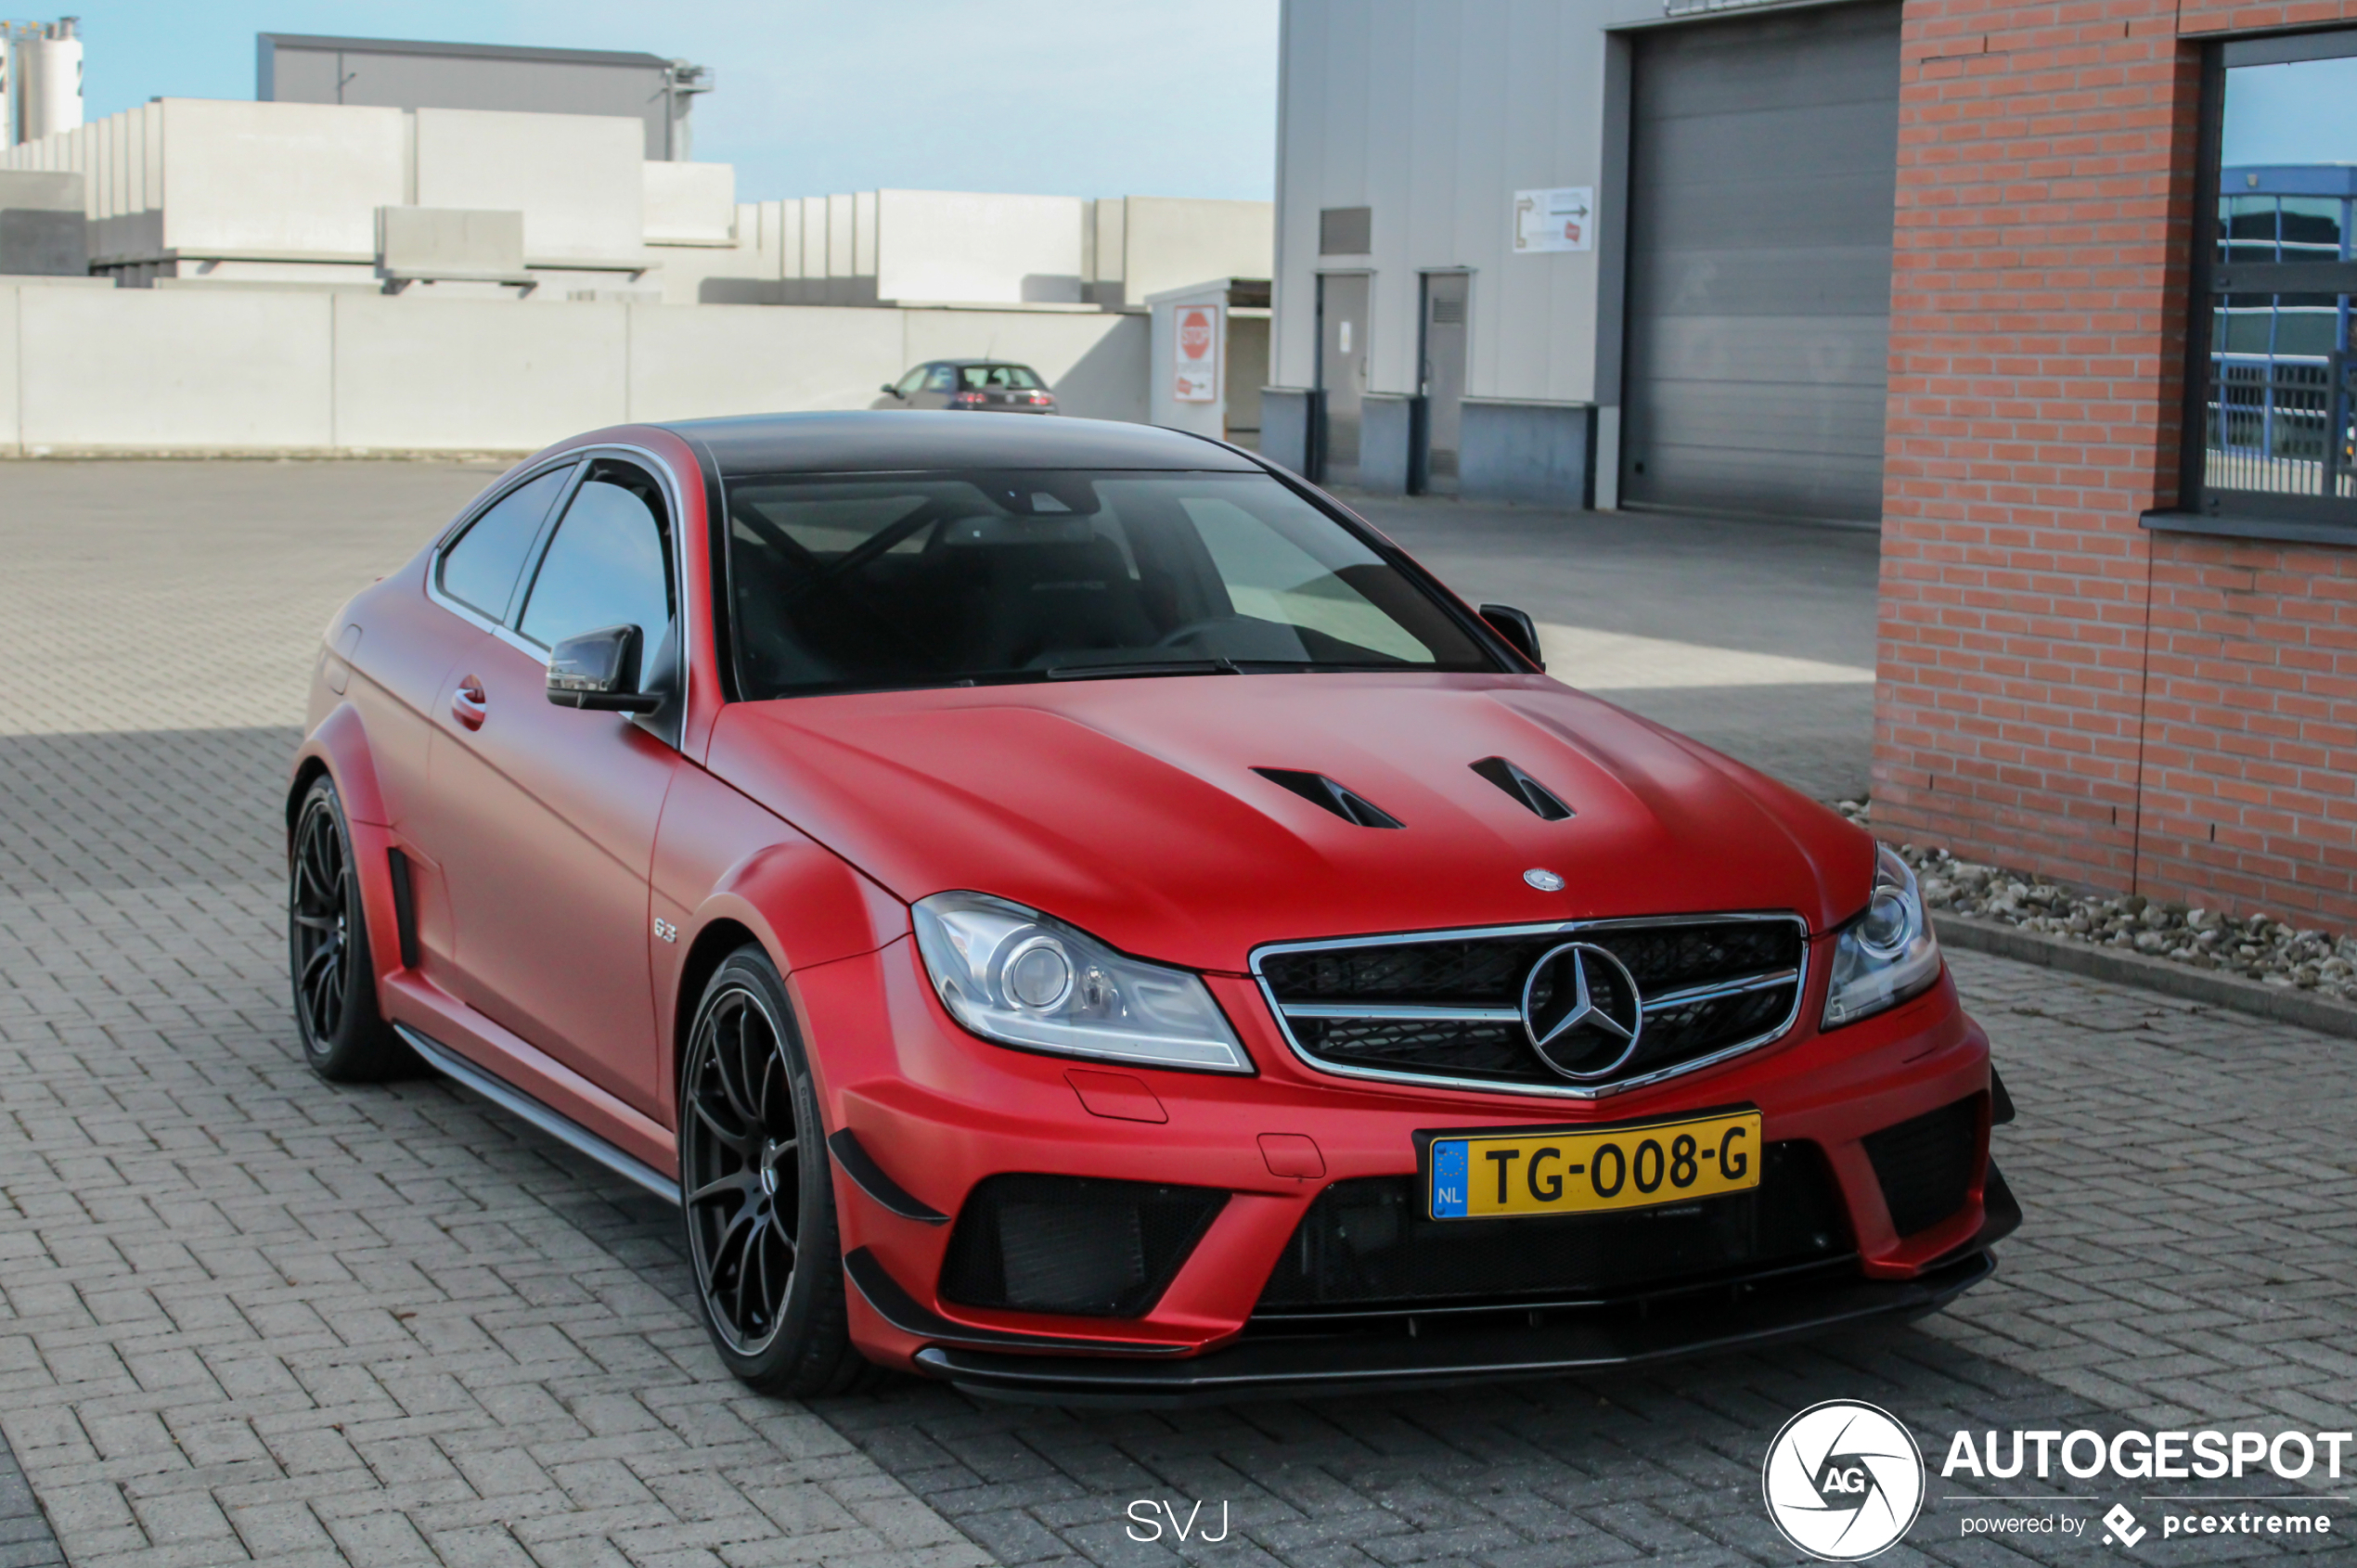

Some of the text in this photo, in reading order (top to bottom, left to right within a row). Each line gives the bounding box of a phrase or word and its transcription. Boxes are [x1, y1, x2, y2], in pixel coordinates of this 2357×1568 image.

[654, 918, 676, 943] 63
[1485, 1125, 1747, 1204] TG-008-G
[1437, 1188, 1462, 1204] NL
